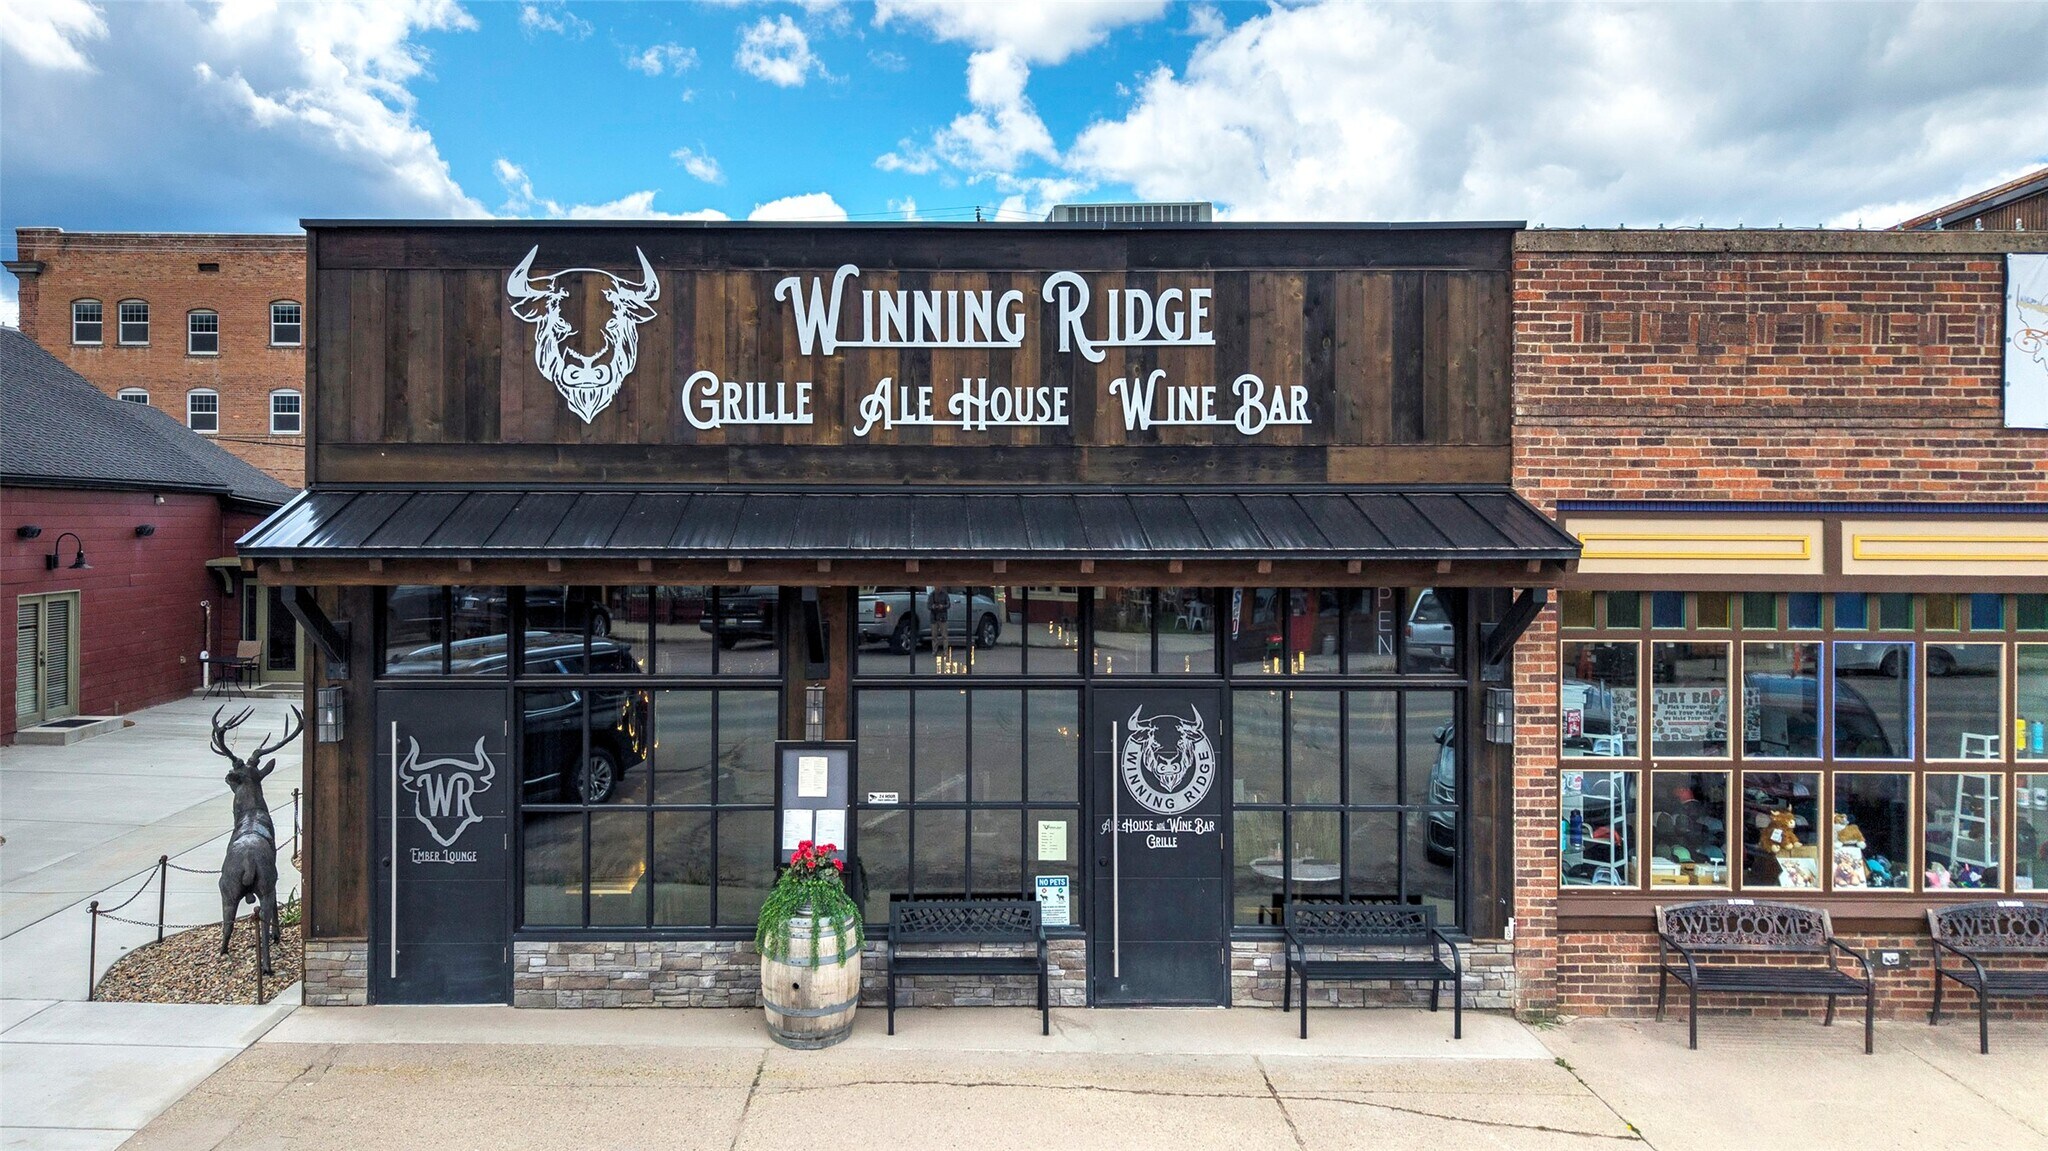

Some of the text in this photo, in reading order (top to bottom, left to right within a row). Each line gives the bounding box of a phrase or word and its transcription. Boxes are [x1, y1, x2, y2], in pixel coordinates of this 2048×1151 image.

[774, 264, 1216, 363] WINNING RIDGE
[682, 369, 1312, 437] GRILLE ALE HOUSE WINE BAR
[1377, 586, 1393, 656] PEN
[1657, 692, 1686, 705] HAT
[1126, 750, 1210, 809] WINNING RIDGE
[1122, 818, 1154, 834] HOUSE
[1167, 816, 1193, 834] WINE
[1194, 817, 1216, 835] BAR
[1146, 833, 1178, 850] GRILLE
[409, 847, 478, 865] EMBER LOUNGE
[1039, 878, 1066, 886] NO PETS
[1678, 914, 1812, 937] WELCOME
[1951, 916, 2048, 940] WELCO
